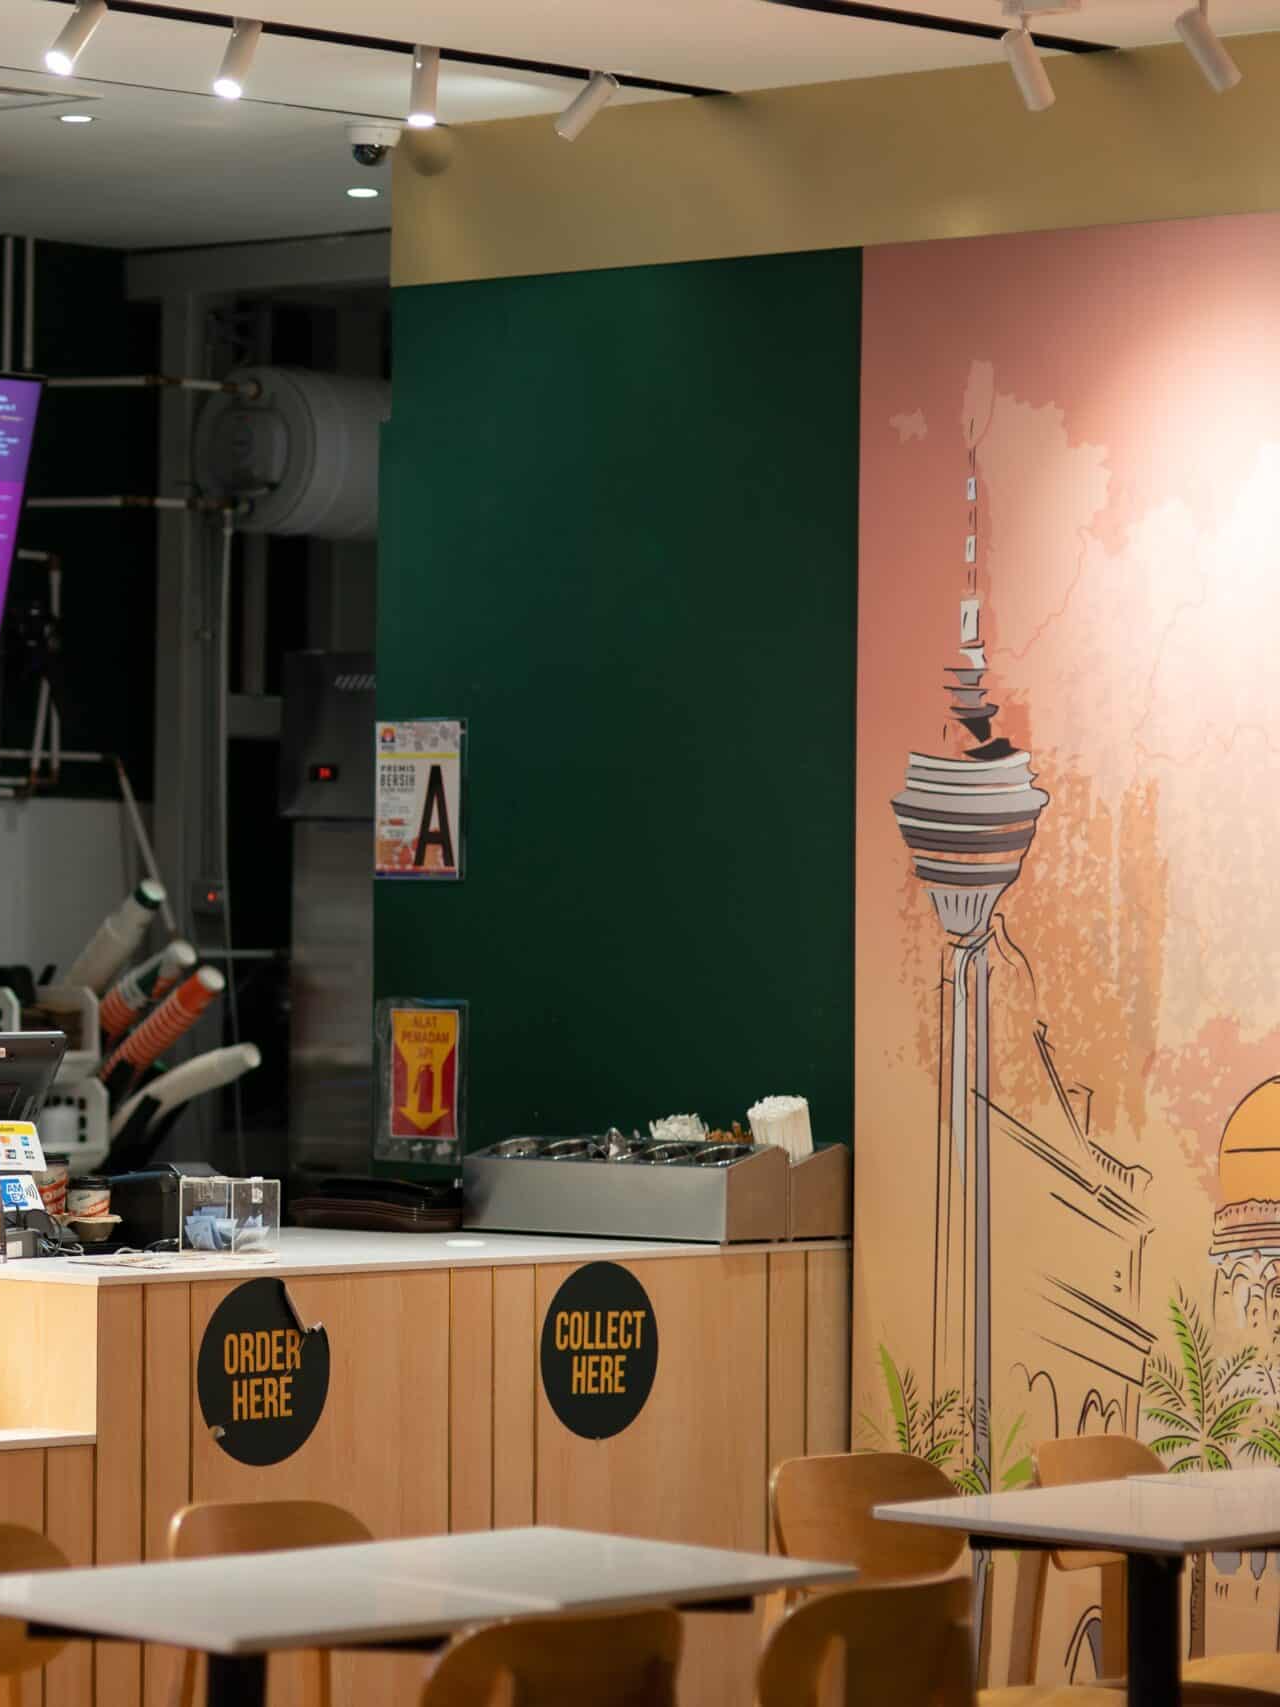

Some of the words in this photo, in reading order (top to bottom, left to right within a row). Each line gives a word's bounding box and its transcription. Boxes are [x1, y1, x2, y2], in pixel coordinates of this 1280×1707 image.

[380, 774, 415, 787] BERSIH
[413, 764, 455, 867] A
[402, 1031, 449, 1043] PEMADAM
[413, 1016, 437, 1028] ALAT
[555, 1311, 646, 1351] COLLECT
[223, 1328, 302, 1375] ORDER
[571, 1354, 626, 1395] HERE
[232, 1375, 293, 1421] HERE
